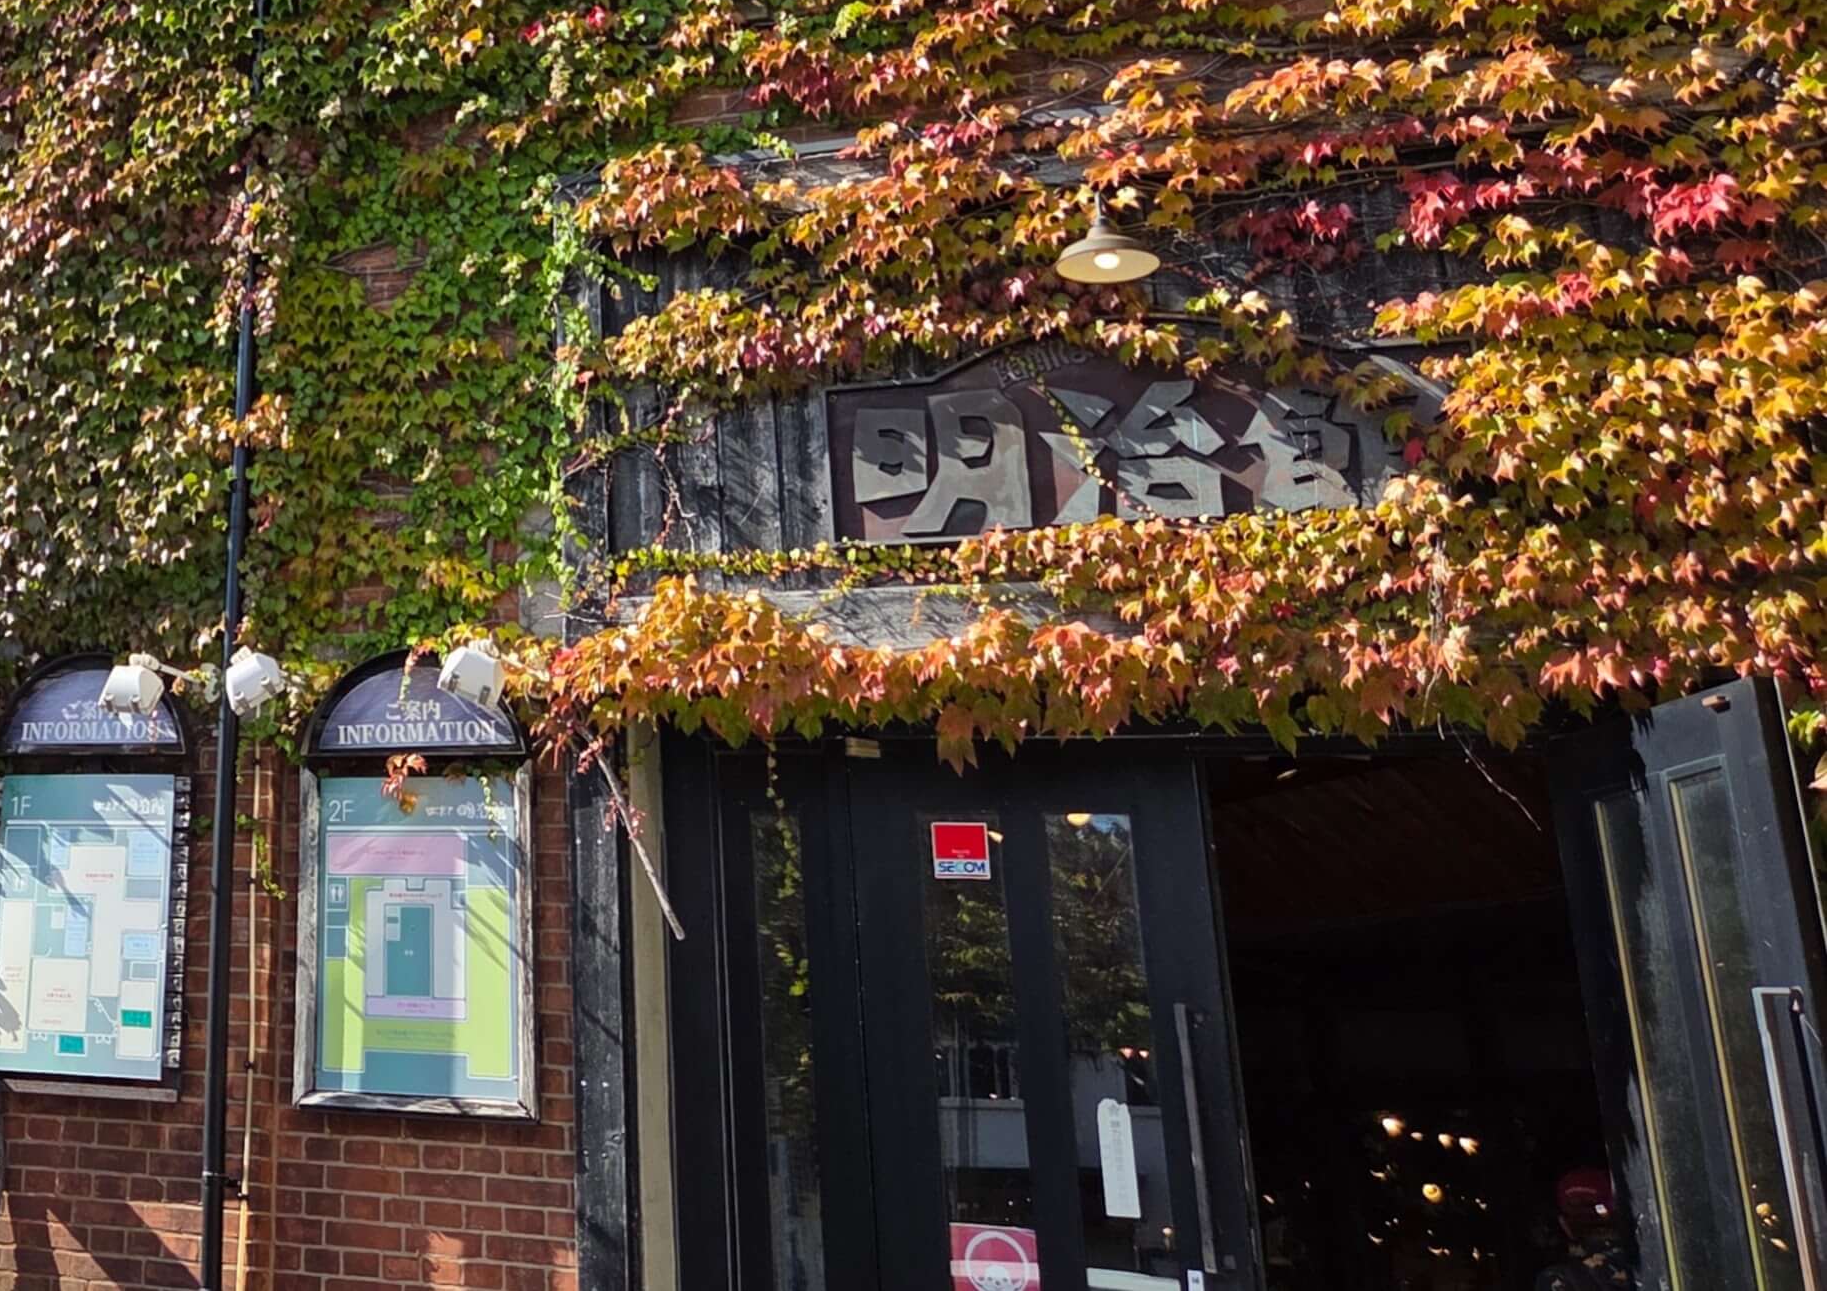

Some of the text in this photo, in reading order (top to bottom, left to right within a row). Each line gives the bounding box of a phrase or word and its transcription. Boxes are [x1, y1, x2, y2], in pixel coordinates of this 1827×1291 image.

[385, 699, 442, 722] ご案内
[337, 720, 496, 745] INFORMATION
[11, 795, 33, 817] 1F
[328, 799, 356, 822] 2F
[938, 861, 986, 873] SECOM
